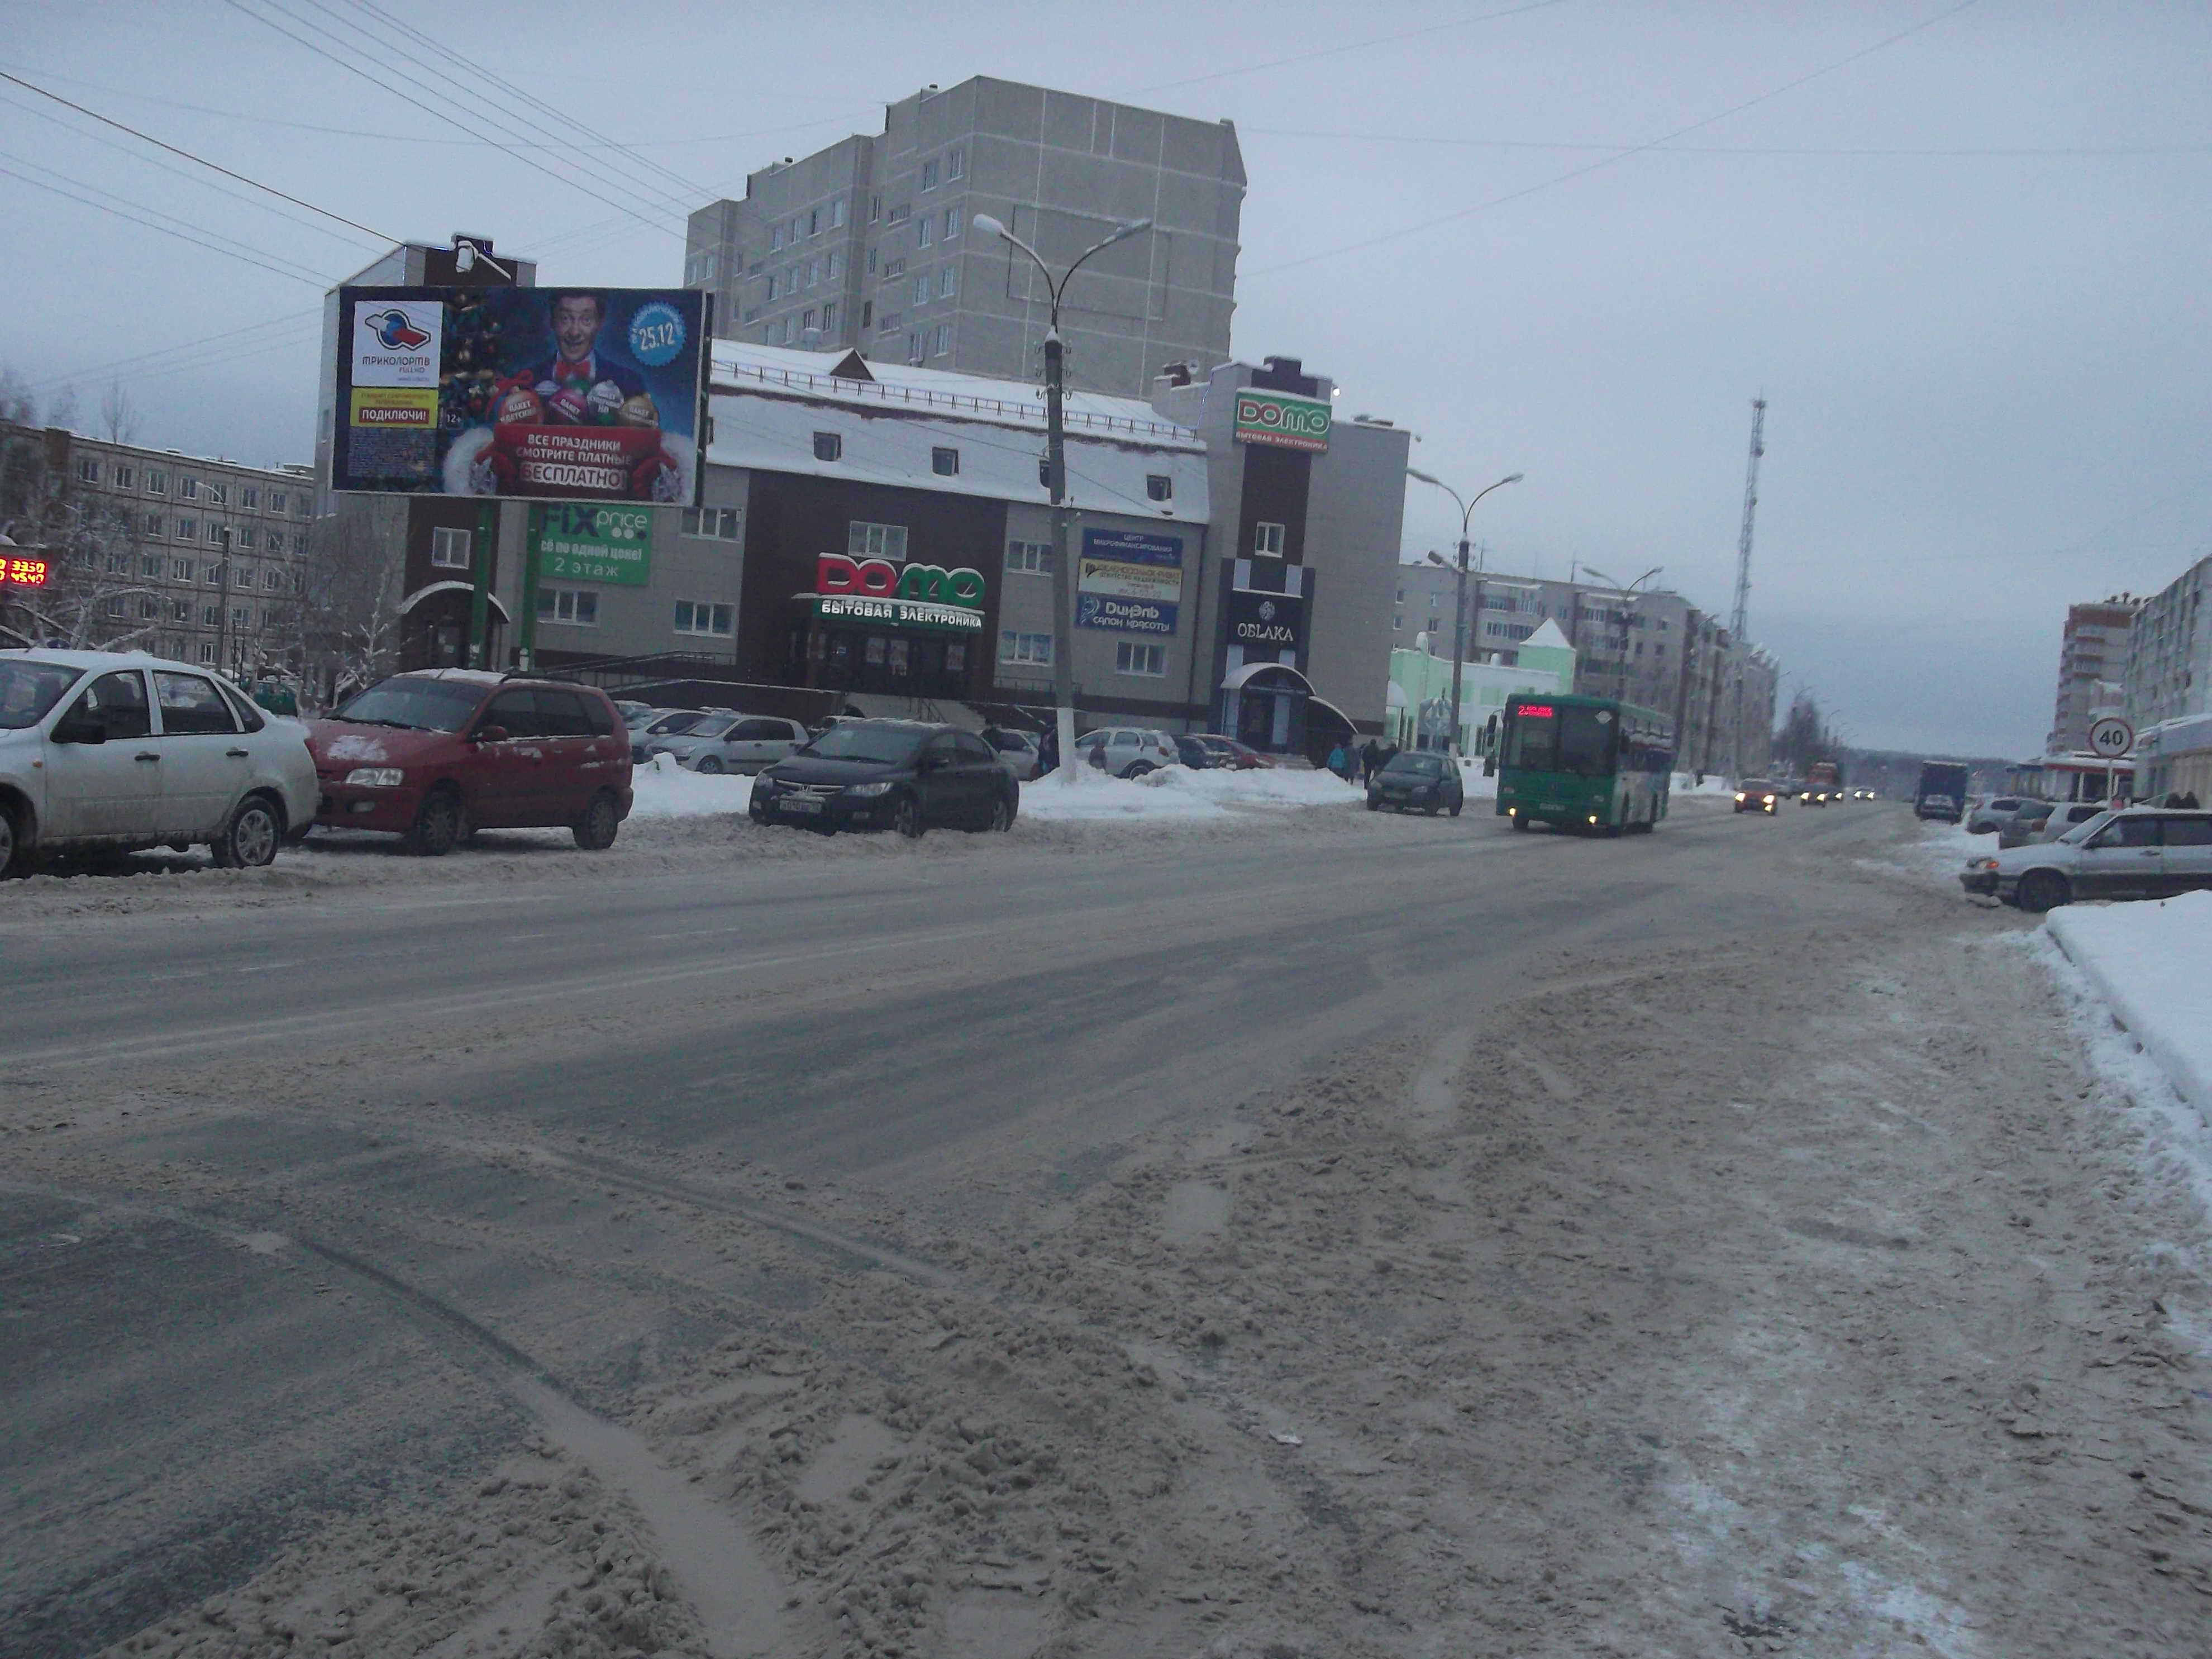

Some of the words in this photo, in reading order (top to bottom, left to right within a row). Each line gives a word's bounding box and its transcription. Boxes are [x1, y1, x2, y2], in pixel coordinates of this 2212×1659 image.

[638, 322, 675, 351] 25.12
[362, 409, 426, 422] ПОДКЛЮЧИ!
[447, 414, 461, 423] 12+
[527, 433, 549, 446] ВСЕ
[552, 436, 621, 451] ПРАЗДНИКИ
[516, 446, 575, 461] СМОТРИТЕ
[596, 511, 648, 529] price
[555, 557, 565, 571] 2
[572, 562, 618, 576] этаж
[822, 602, 893, 618] БЫТОВАЯ
[899, 606, 983, 628] ЭЛЕКТРОНИКА
[2099, 730, 2123, 746] 40
